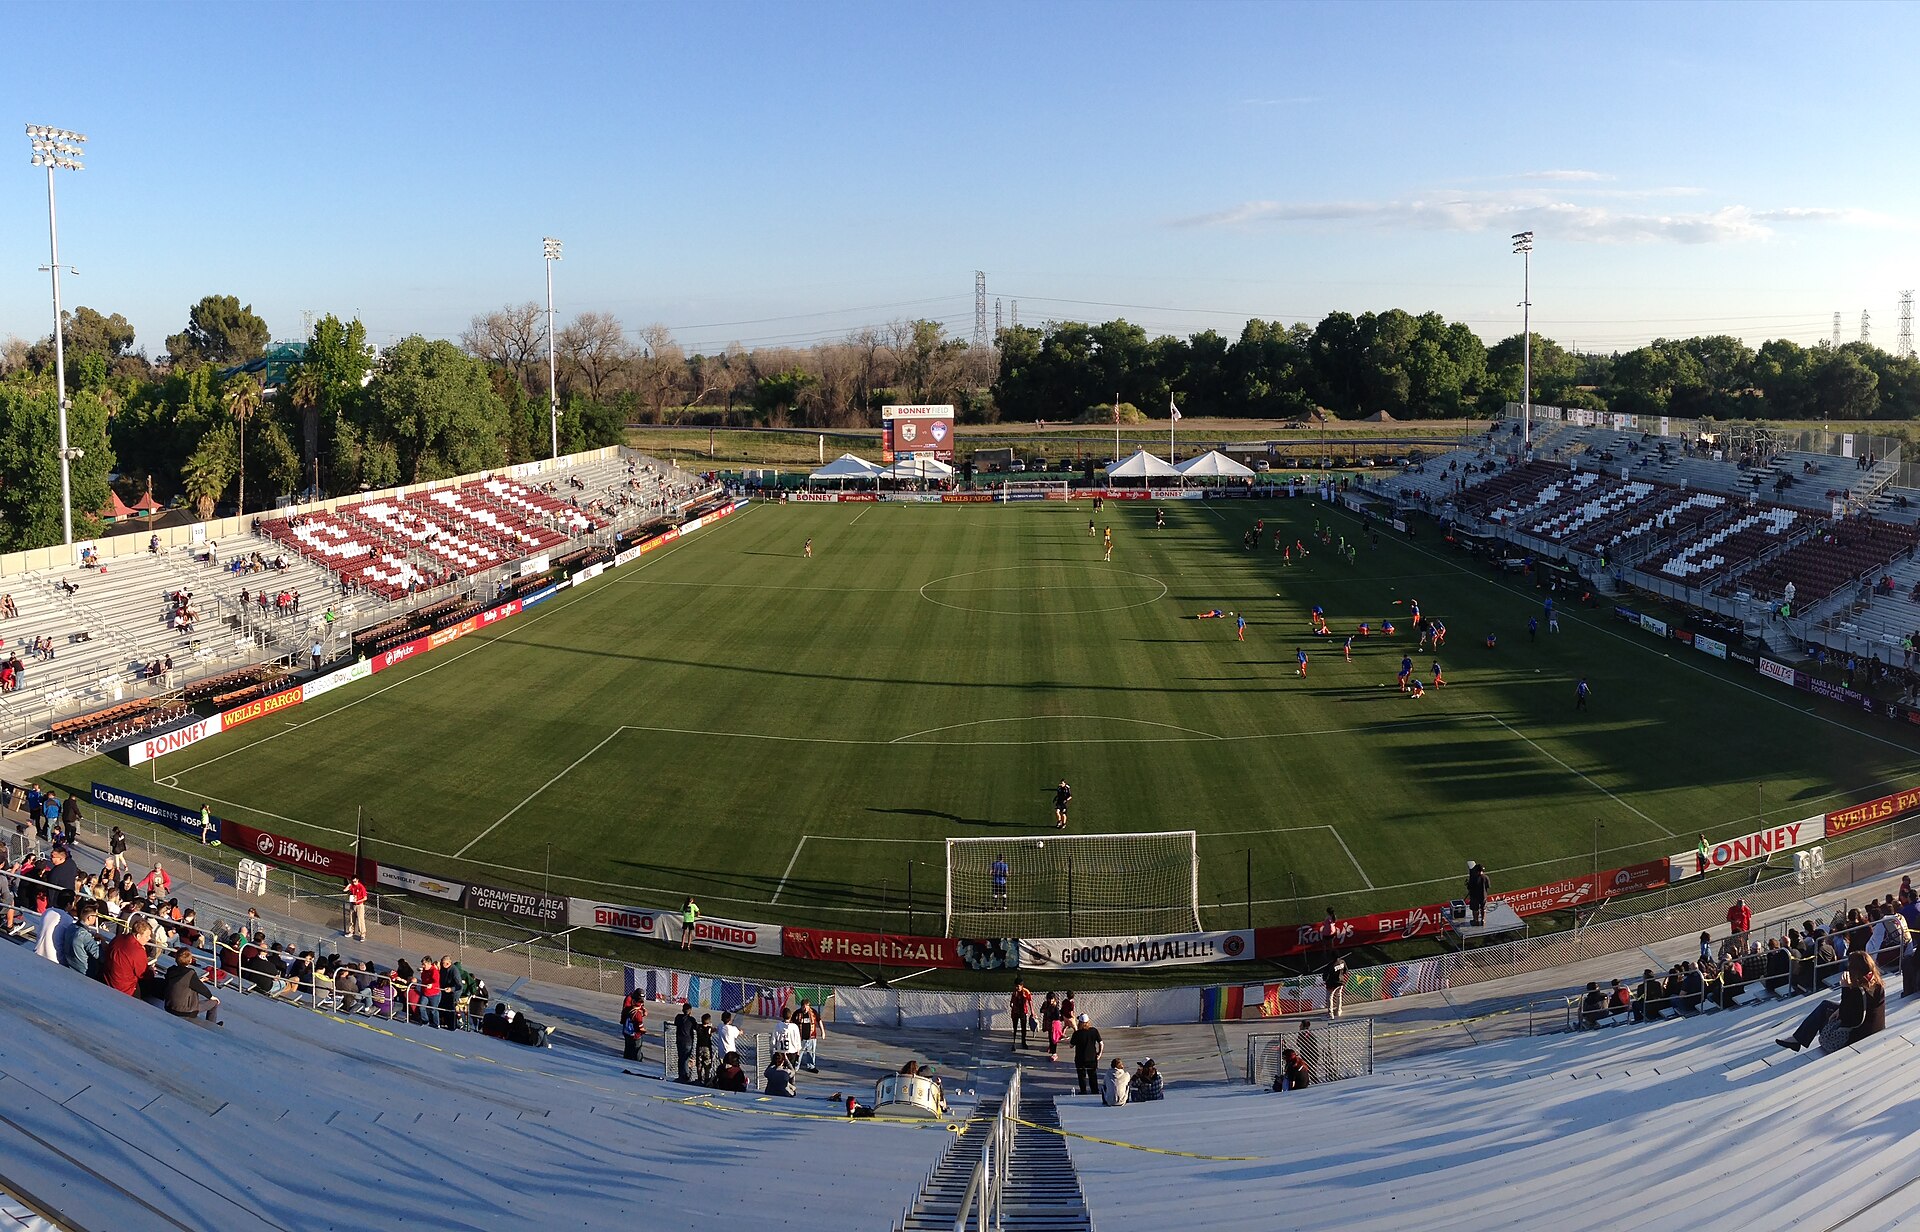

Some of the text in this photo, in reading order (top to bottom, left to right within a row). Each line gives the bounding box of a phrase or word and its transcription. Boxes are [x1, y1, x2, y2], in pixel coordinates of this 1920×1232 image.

[1811, 678, 1827, 689] MAKE
[1832, 684, 1845, 695] LATE
[1845, 688, 1862, 700] NIGHT
[1811, 685, 1829, 697] FOODY
[223, 688, 301, 726] WELLS FARGO
[146, 720, 208, 758] BONNEY
[136, 802, 179, 821] CHILDREN'S
[180, 814, 217, 833] HOSPAL
[1830, 791, 1920, 831] WELLS FA
[382, 872, 416, 884] CHEVROLET
[1540, 881, 1575, 897] Health
[471, 886, 564, 911] SACRAMENTO AREA
[478, 898, 557, 920] CHEVY DEALERS
[1510, 897, 1553, 913] dvantage
[595, 909, 654, 930] BIMBO
[695, 923, 757, 945] BIMBO
[1296, 922, 1354, 945] Raly's
[1062, 940, 1214, 964] GOOOOAAAAALLLL!
[780, 1040, 790, 1051] 19
